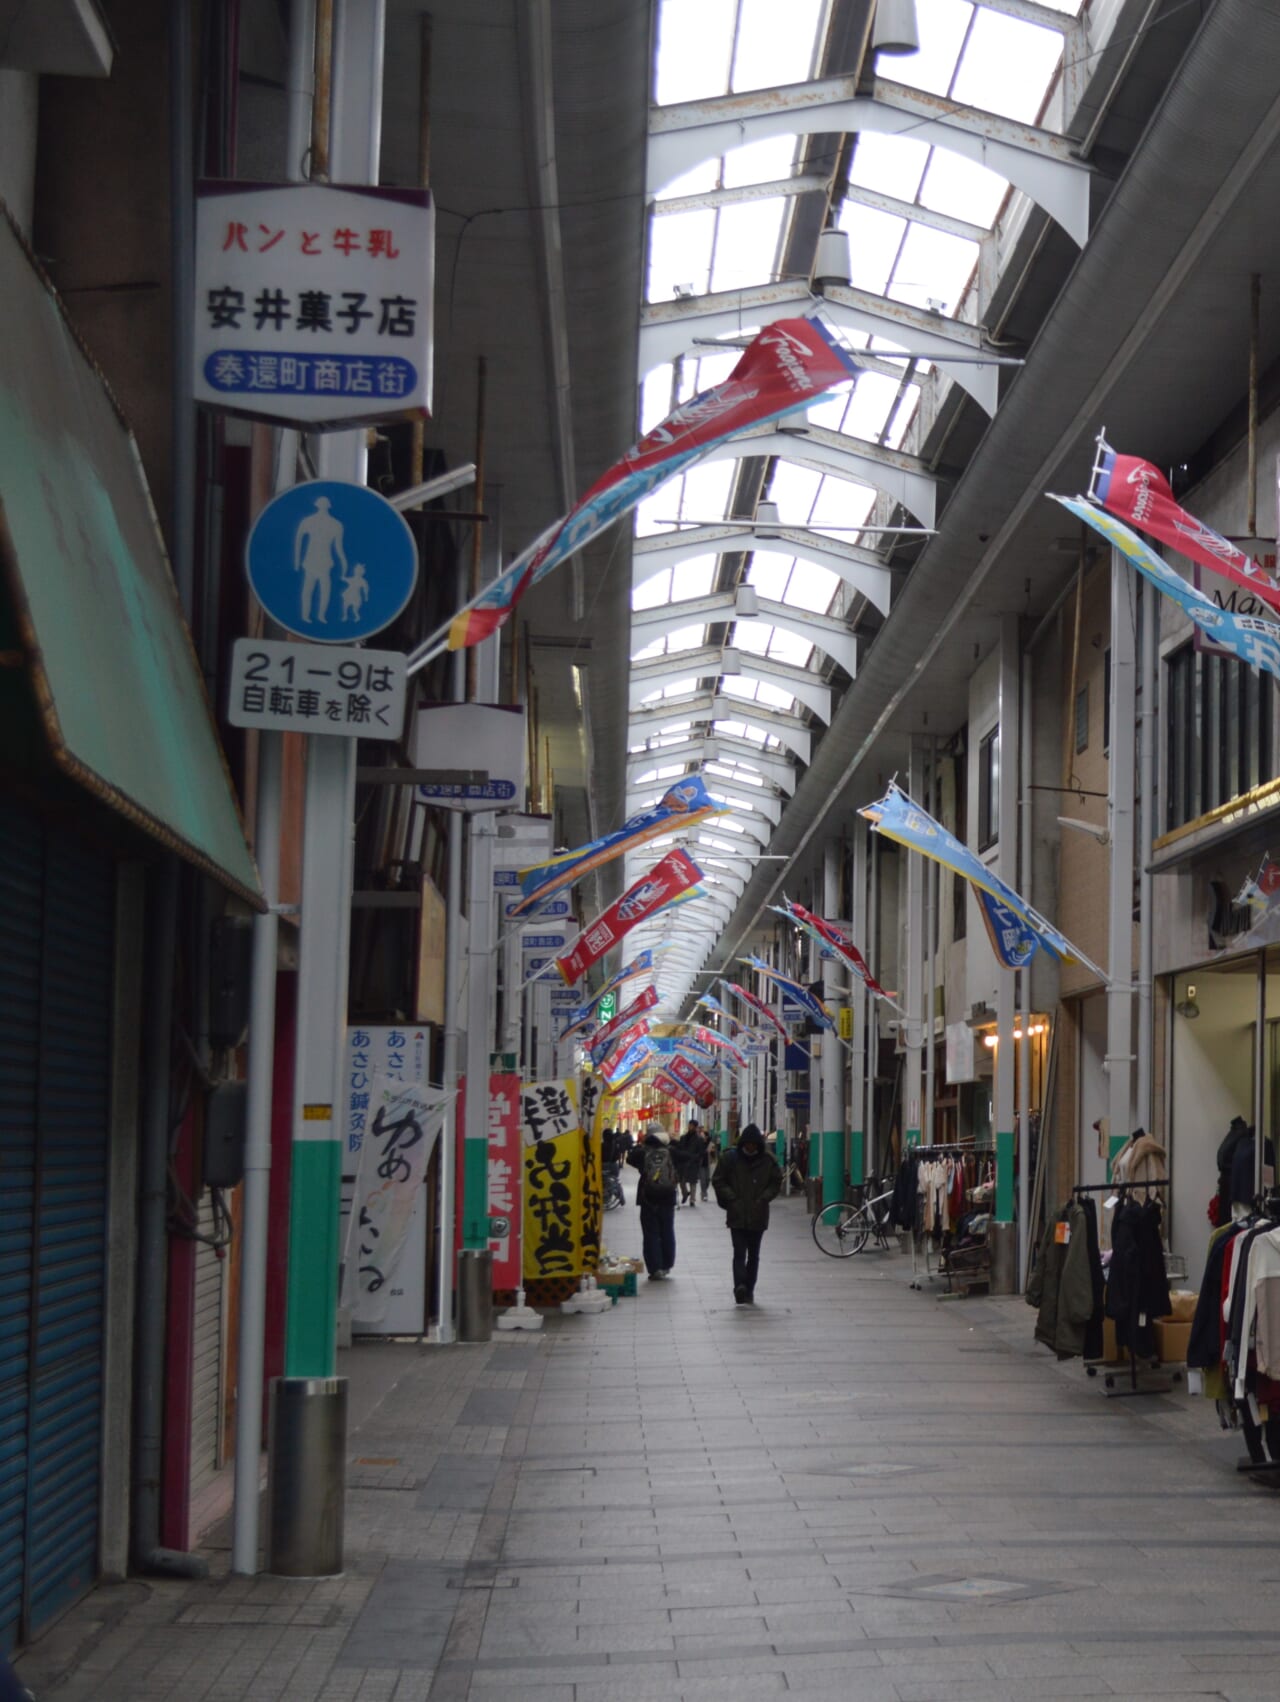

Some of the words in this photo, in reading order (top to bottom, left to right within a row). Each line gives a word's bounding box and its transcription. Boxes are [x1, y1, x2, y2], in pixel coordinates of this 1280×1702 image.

[222, 221, 399, 259] パンと牛乳
[207, 286, 417, 338] 安井菓子店
[214, 354, 408, 395] 奉還町商店街
[242, 685, 391, 727] 自転車を除く
